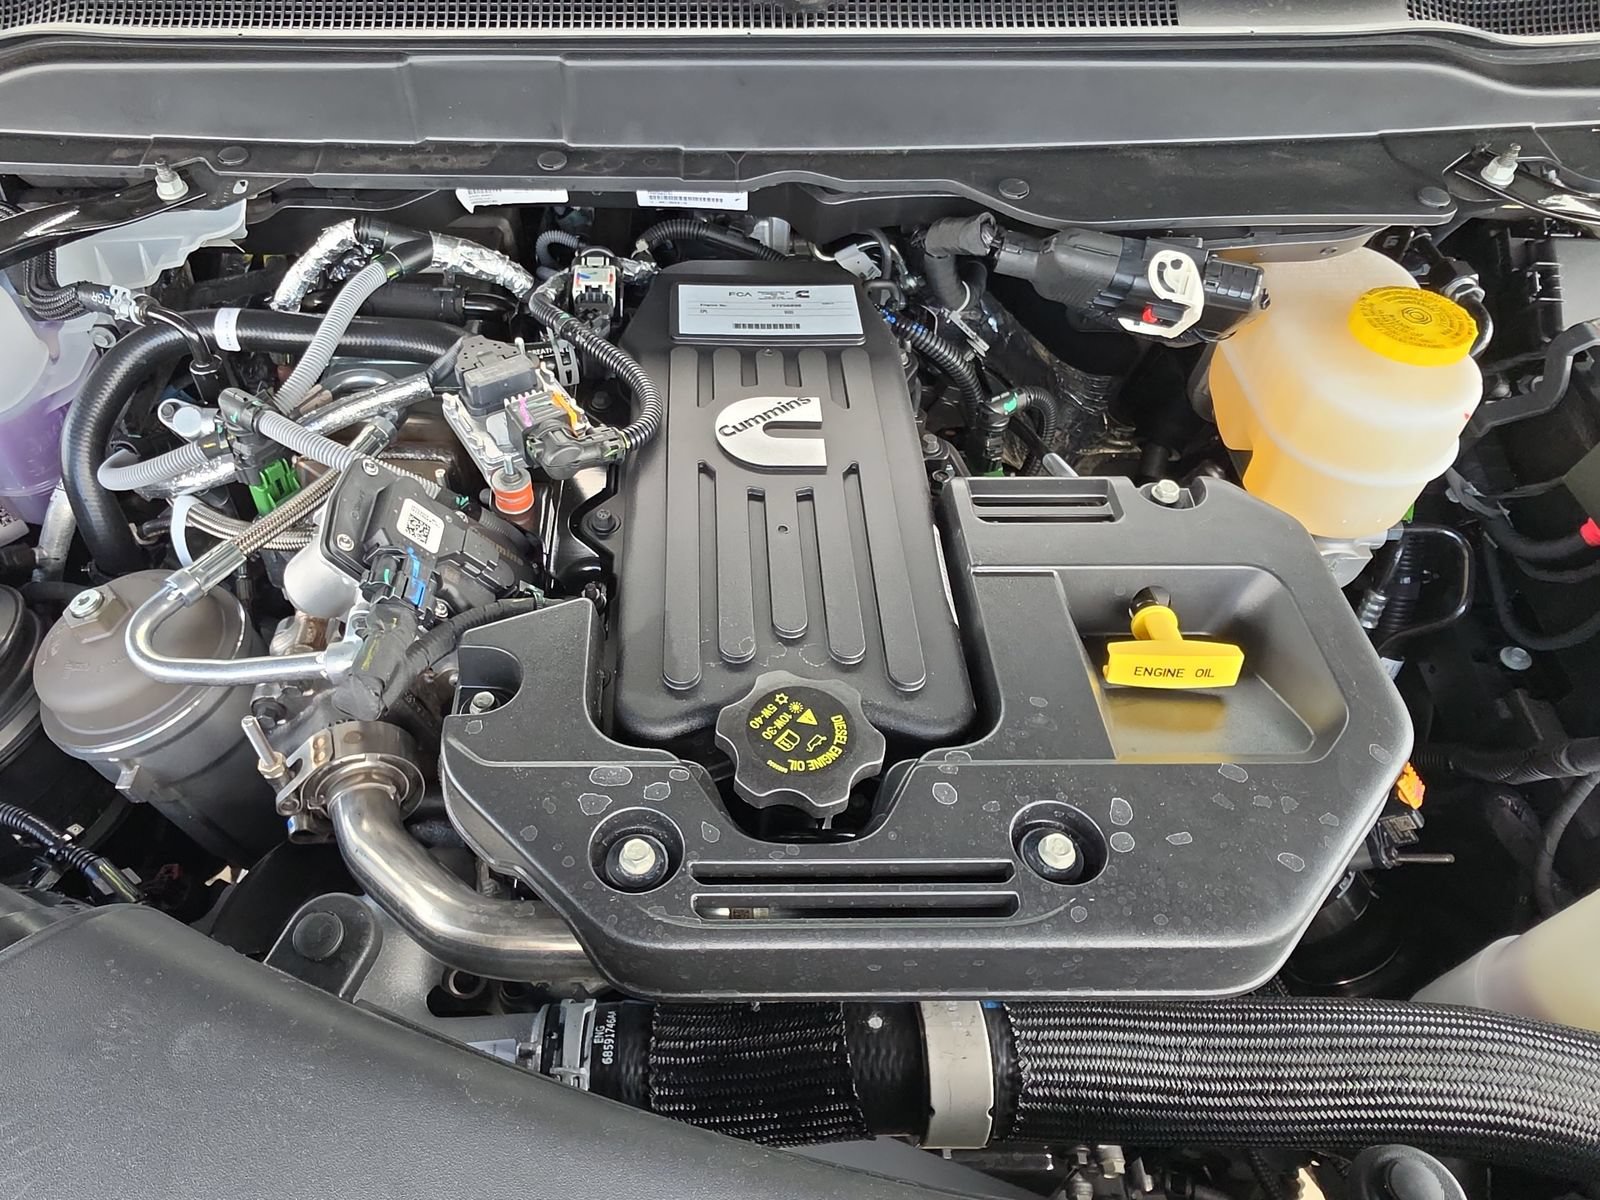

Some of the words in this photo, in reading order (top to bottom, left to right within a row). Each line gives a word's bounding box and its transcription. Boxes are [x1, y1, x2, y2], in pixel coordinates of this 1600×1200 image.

[91, 291, 111, 306] EGR
[718, 397, 812, 437] Cummins
[1133, 666, 1185, 678] ENGINE
[1195, 668, 1215, 678] OIL
[749, 703, 778, 729] 5W-40
[761, 712, 793, 740] 10W-30
[830, 714, 848, 745] DIESEL
[788, 759, 806, 772] OIL
[807, 745, 843, 772] ENGINE
[593, 1025, 606, 1044] ENG
